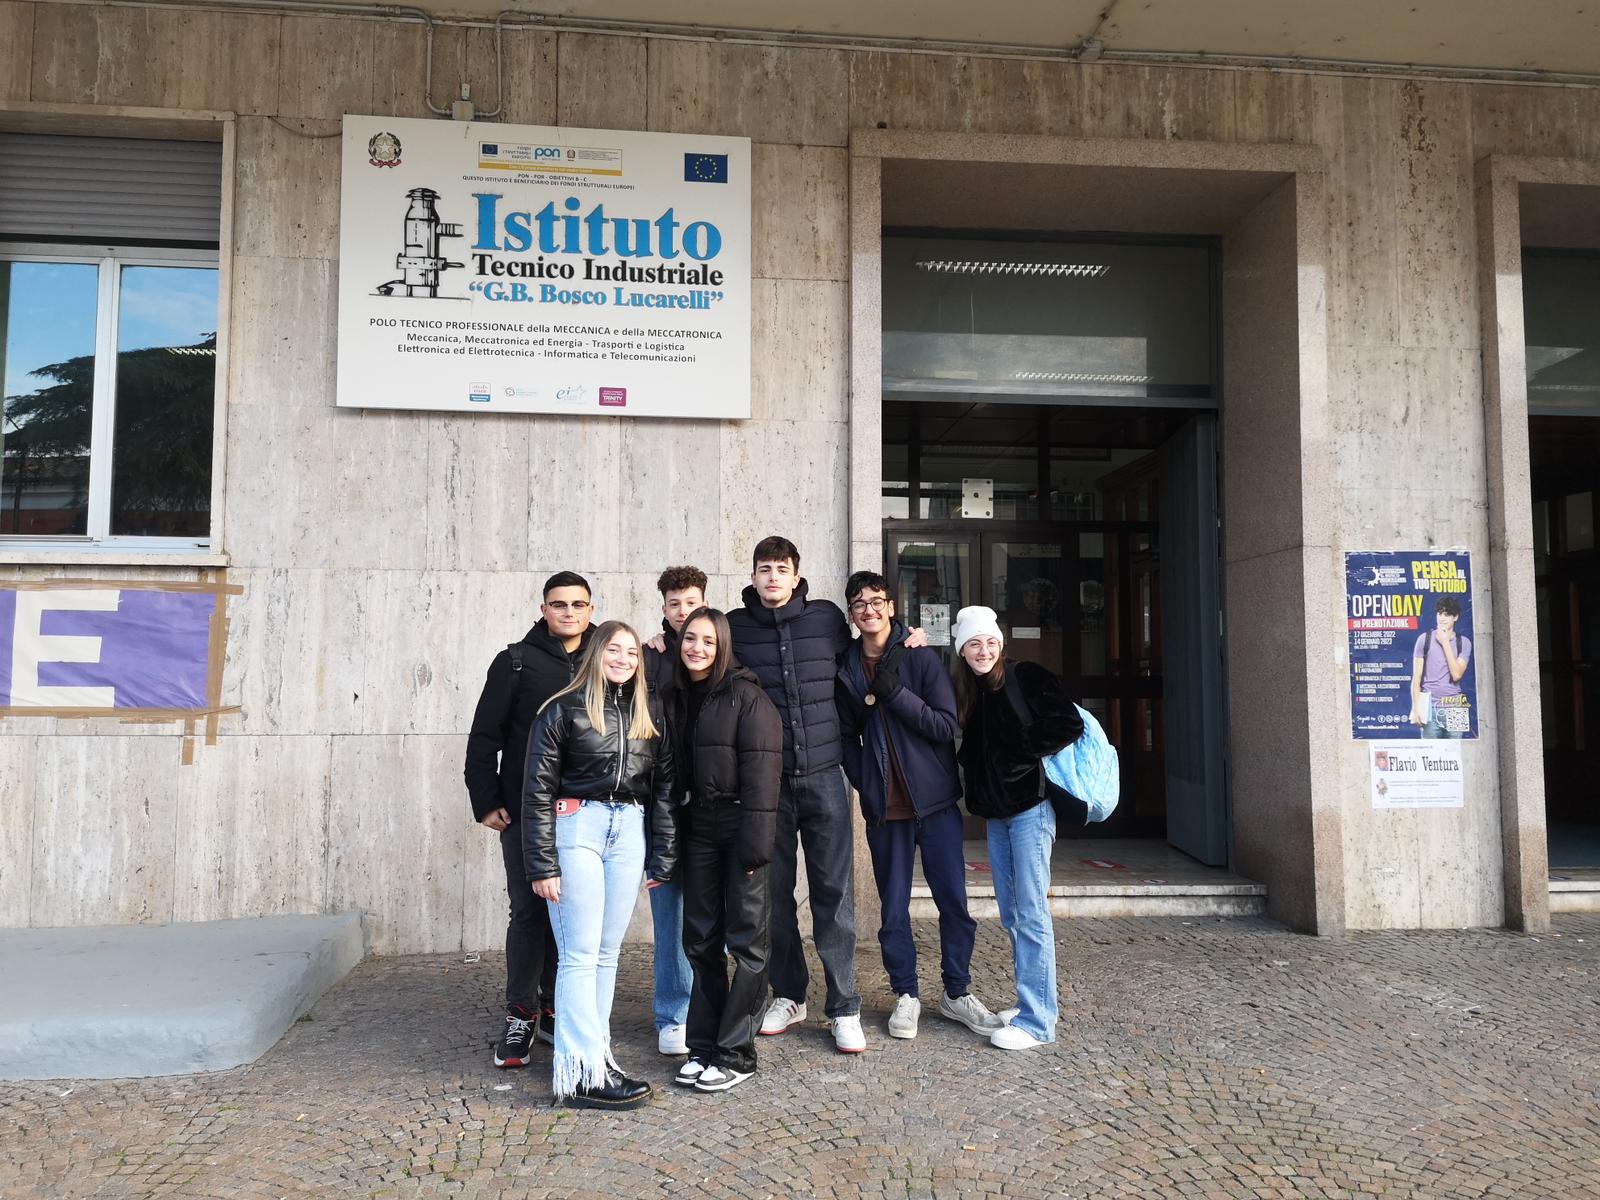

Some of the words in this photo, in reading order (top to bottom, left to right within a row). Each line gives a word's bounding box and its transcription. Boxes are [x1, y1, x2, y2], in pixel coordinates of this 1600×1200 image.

[535, 148, 560, 160] pon
[471, 193, 722, 261] Istituto
[471, 253, 575, 280] Tecnico
[582, 257, 724, 286] Industriale
[538, 283, 607, 306] Bosco
[369, 318, 397, 327] POLO
[400, 319, 443, 329] TECNICO
[445, 321, 524, 332] PROFESSIONALE
[527, 324, 550, 333] della
[553, 325, 611, 335] MECCANICA
[622, 327, 645, 337] della
[647, 328, 722, 340] MECCATRONICA
[407, 333, 462, 344] Meccanica,
[464, 335, 530, 346] Meccatronica
[532, 337, 545, 346] ed
[547, 338, 583, 348] Energia
[592, 339, 634, 350] Trasporti
[636, 342, 642, 350] e
[645, 341, 685, 352] Logistica
[397, 344, 451, 354] Elettronica
[453, 346, 466, 355] ed
[468, 347, 535, 358] Elettrotecnica
[544, 350, 599, 360] Informatica
[601, 352, 607, 360] e
[610, 352, 696, 363] Telecomunicazioni
[1412, 560, 1458, 580] PENSA
[1413, 578, 1430, 590] TUO
[1430, 578, 1467, 593] FUTURO
[1361, 618, 1409, 628] PRENOTAZIONE
[1388, 756, 1417, 772] Flavio
[1422, 756, 1459, 772] Ventura
